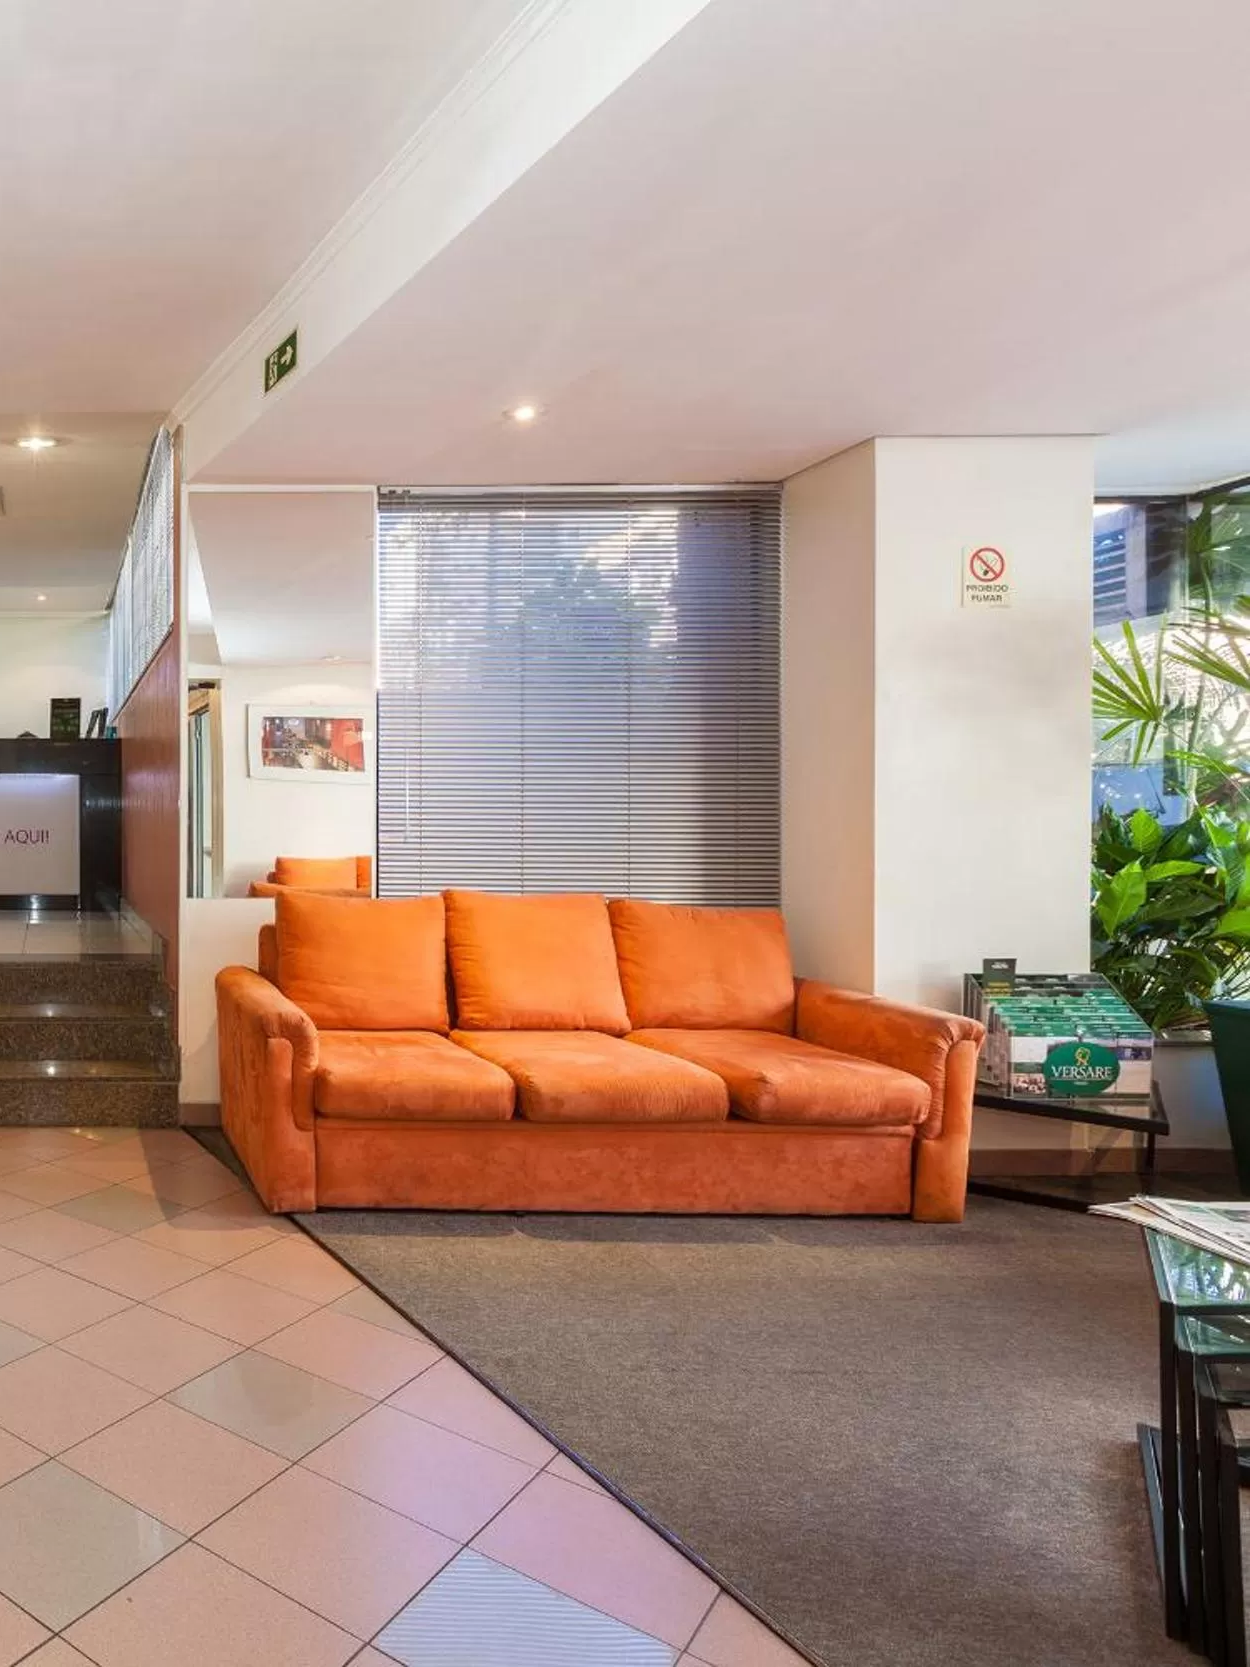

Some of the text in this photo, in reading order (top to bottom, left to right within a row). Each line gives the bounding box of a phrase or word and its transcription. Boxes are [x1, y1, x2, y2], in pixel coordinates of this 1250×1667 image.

[966, 584, 1009, 592] PROIBIDO
[971, 594, 1002, 602] FUMAR
[4, 829, 50, 844] AQUI!
[1051, 1065, 1112, 1079] VERSARE
